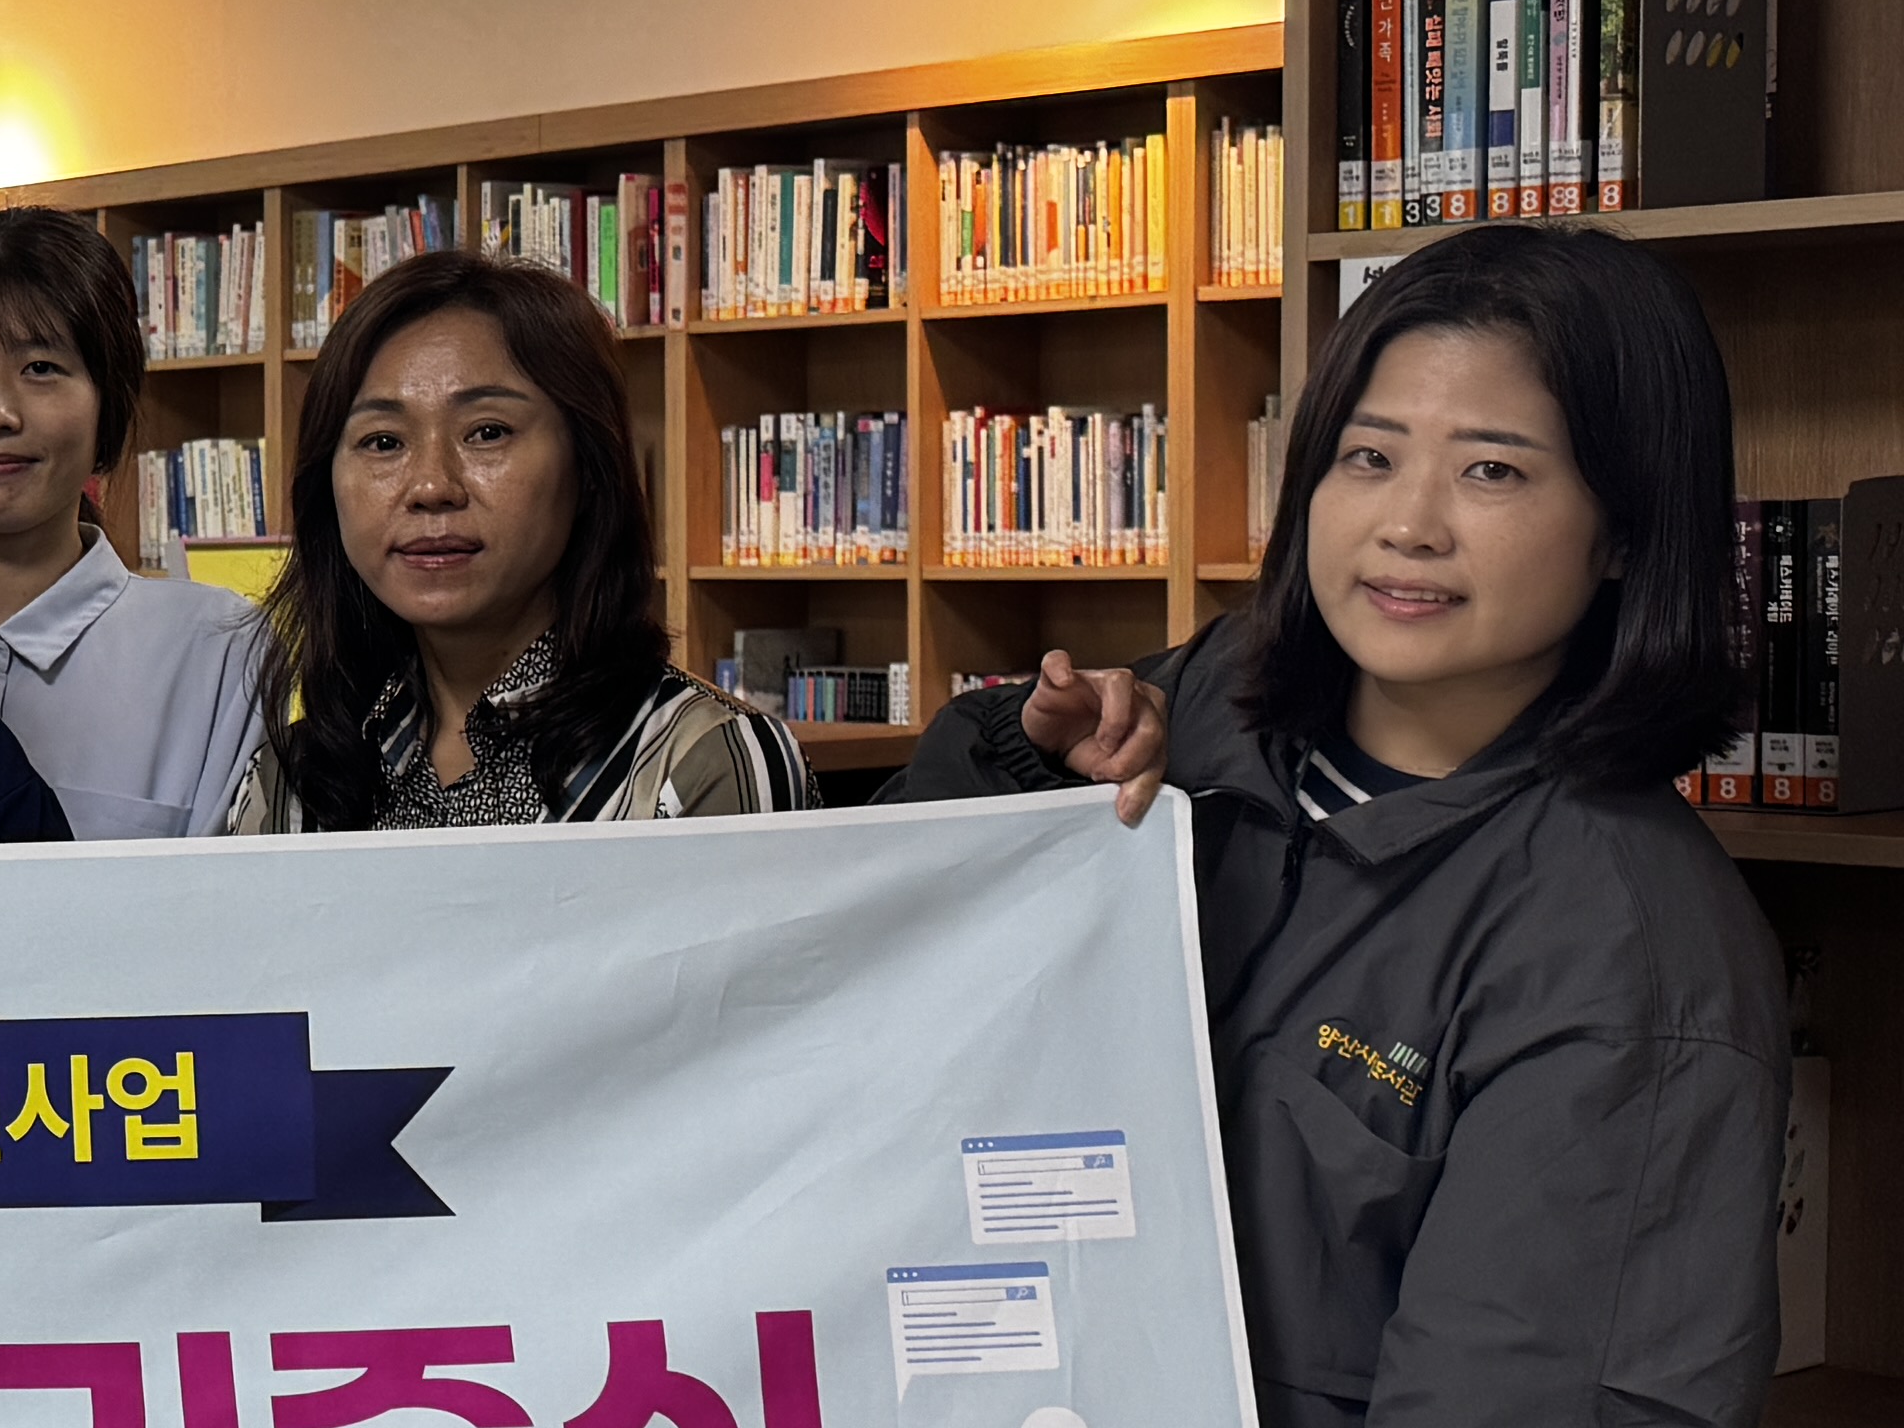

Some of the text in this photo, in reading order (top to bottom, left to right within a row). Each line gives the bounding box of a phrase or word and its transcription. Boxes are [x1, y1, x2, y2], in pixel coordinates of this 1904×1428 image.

[1377, 18, 1393, 63] 가족
[1426, 194, 1440, 217] 3
[1449, 192, 1467, 217] 8
[1492, 191, 1510, 213] 8
[1520, 185, 1538, 210] 8
[1603, 183, 1621, 207] 8
[1405, 201, 1421, 224] 3
[1718, 775, 1738, 800] 8
[1773, 775, 1791, 800] 8
[1315, 1022, 1426, 1110] 양산시도서관
